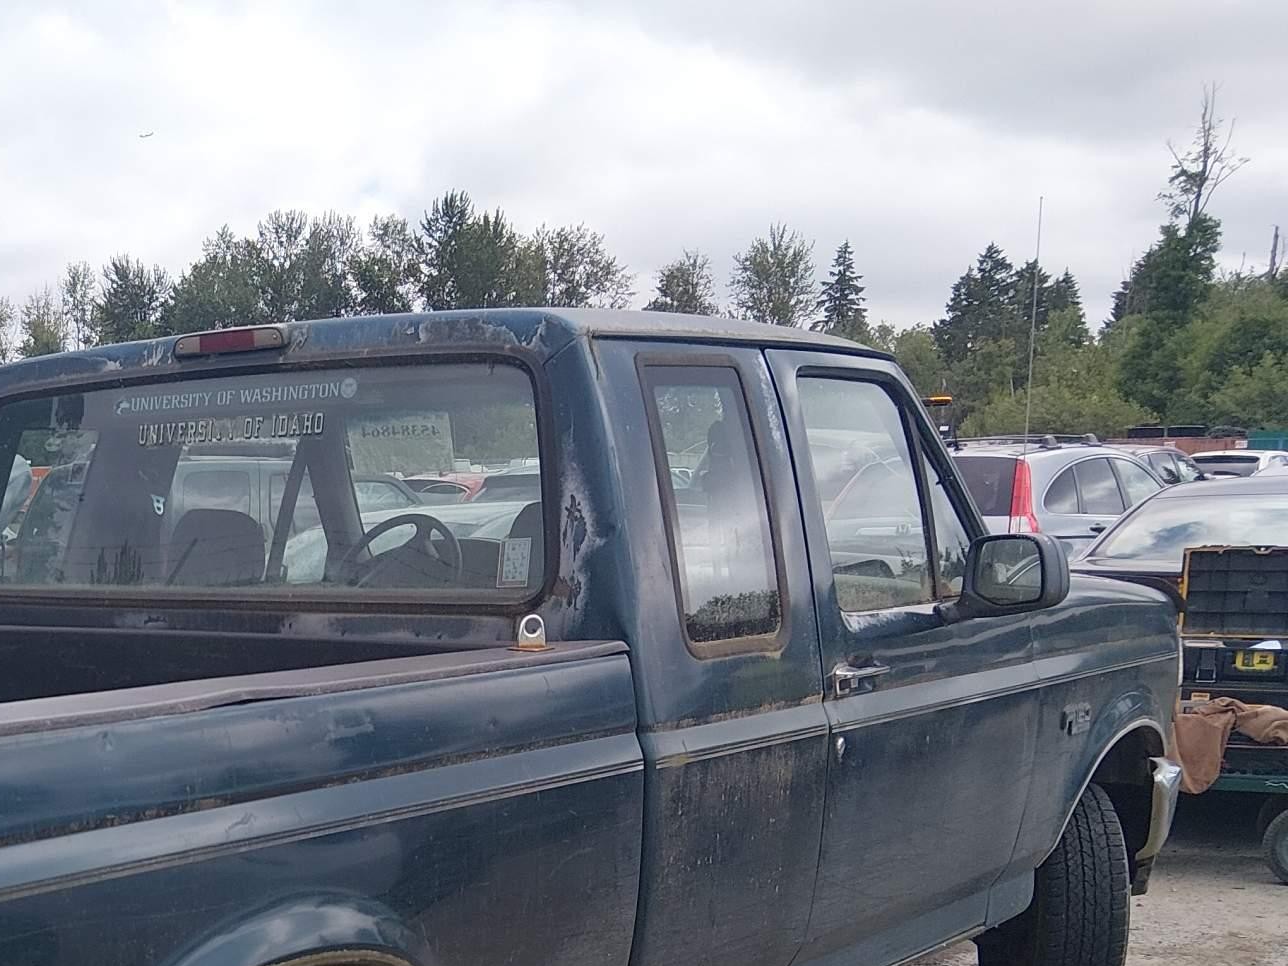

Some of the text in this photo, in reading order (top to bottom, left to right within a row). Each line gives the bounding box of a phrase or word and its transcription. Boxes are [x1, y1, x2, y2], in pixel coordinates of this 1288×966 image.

[130, 382, 341, 412] UNIVERSITY OF WASHINGTON
[138, 411, 325, 446] UNIVERSI OF IDAHO
